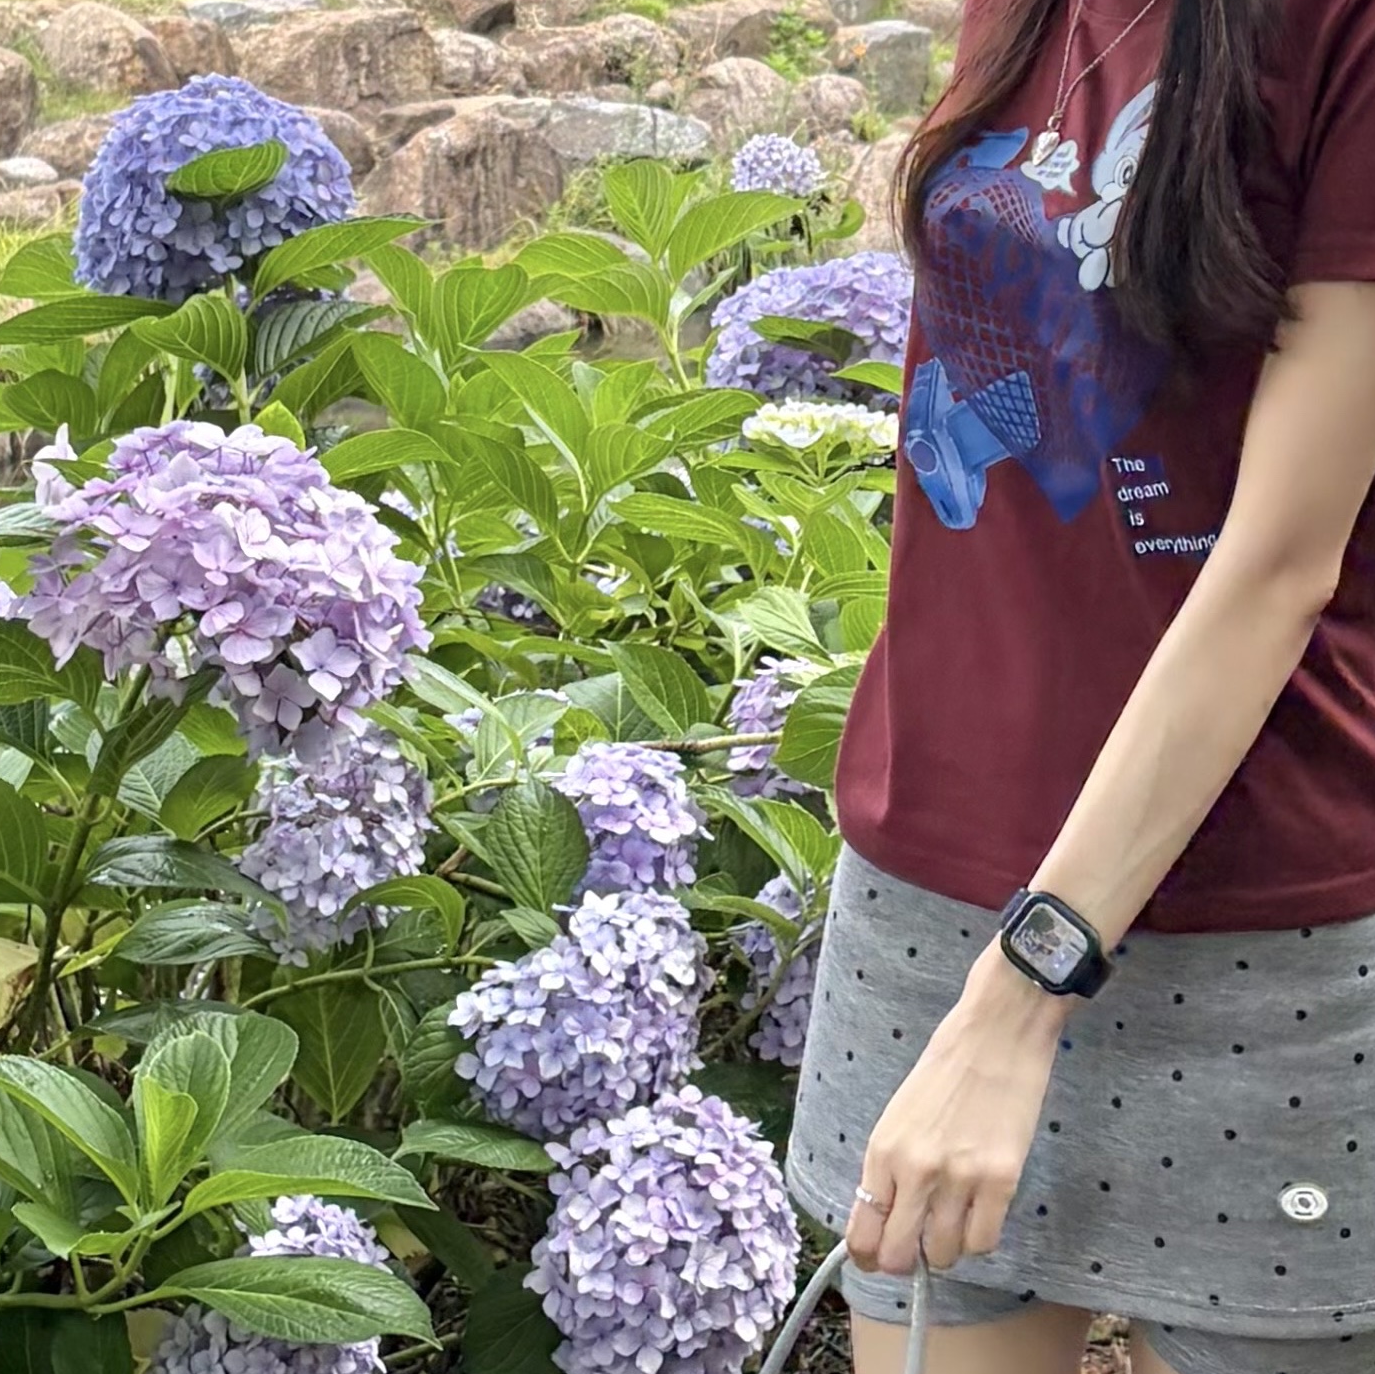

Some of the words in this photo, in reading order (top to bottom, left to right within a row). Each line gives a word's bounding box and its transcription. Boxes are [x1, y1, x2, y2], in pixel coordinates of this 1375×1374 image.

[1111, 457, 1146, 473] The
[1117, 481, 1170, 502] dream
[1129, 509, 1145, 526] is
